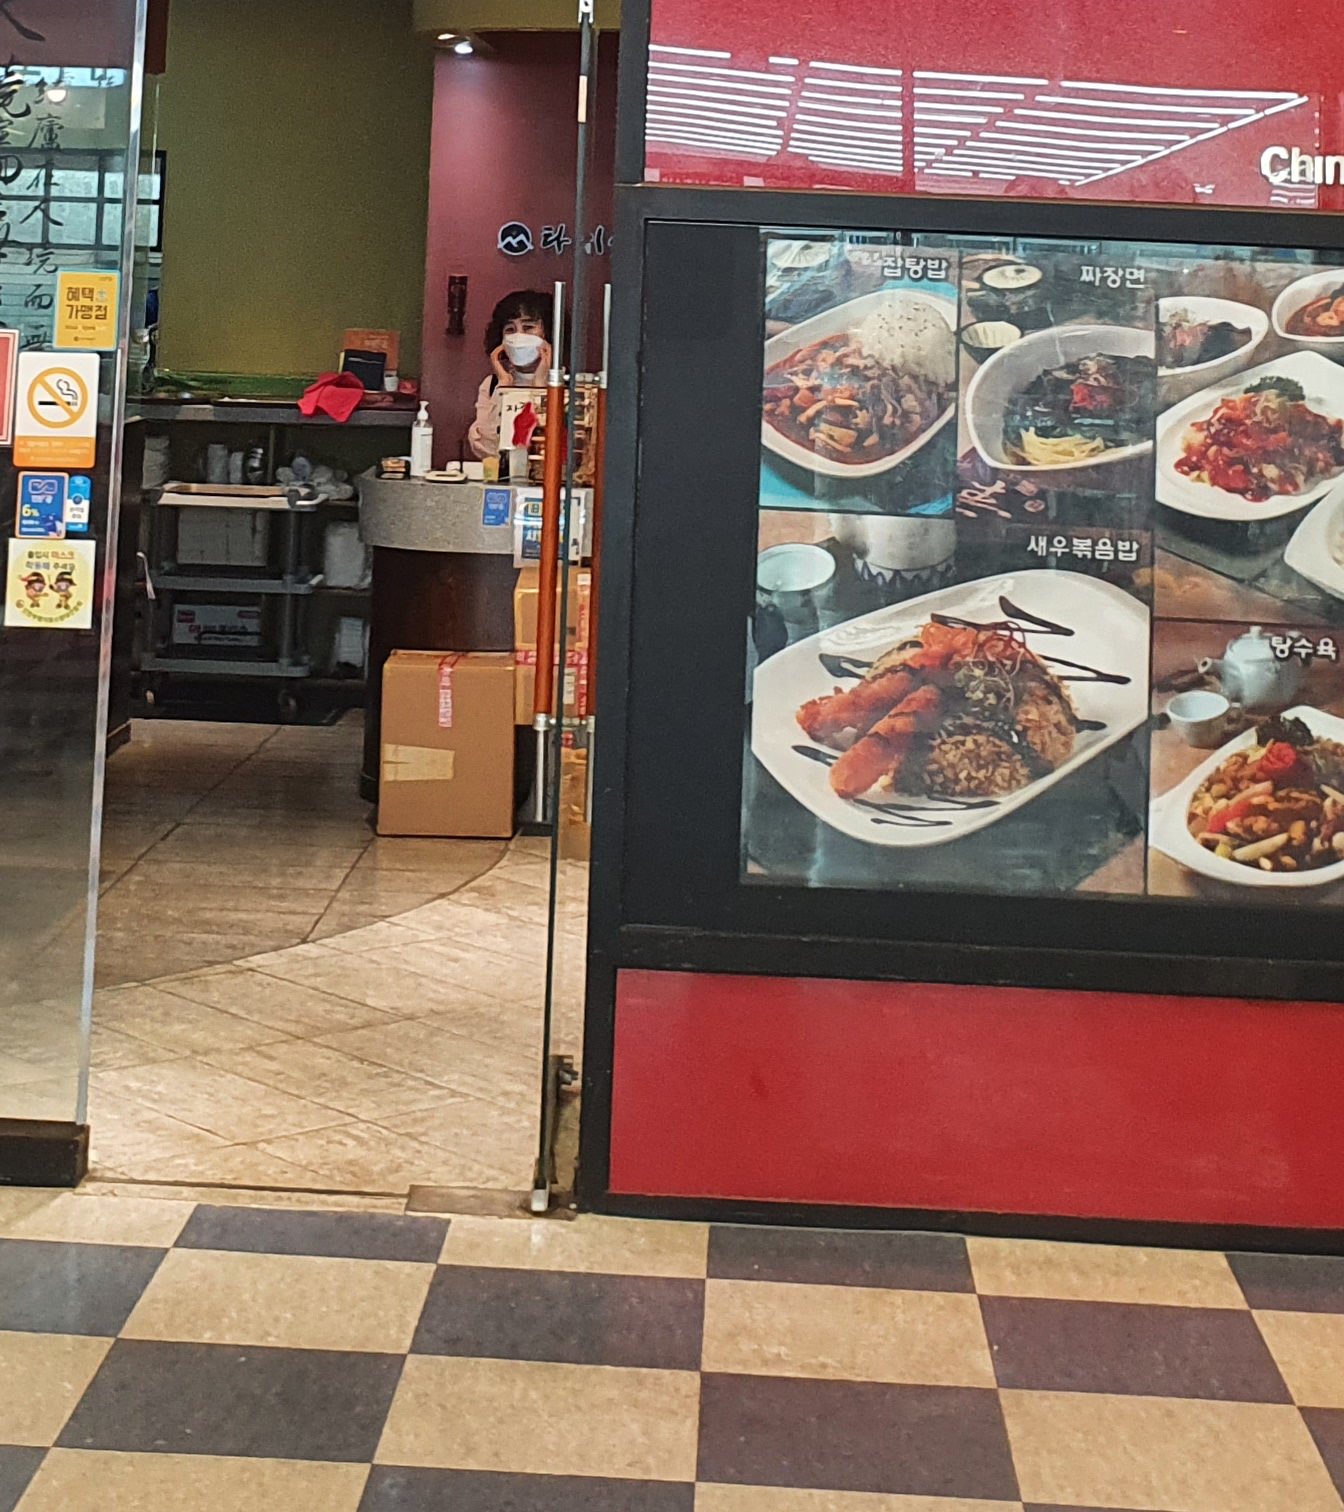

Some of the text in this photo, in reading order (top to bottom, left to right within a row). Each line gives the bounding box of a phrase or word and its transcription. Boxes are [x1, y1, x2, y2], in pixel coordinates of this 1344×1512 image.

[1079, 265, 1146, 289] 짜장면
[65, 286, 95, 302] 혜택
[64, 304, 108, 321] 가맹점
[1026, 535, 1140, 561] 새우볶음밥
[1271, 636, 1337, 660] 탕수육
